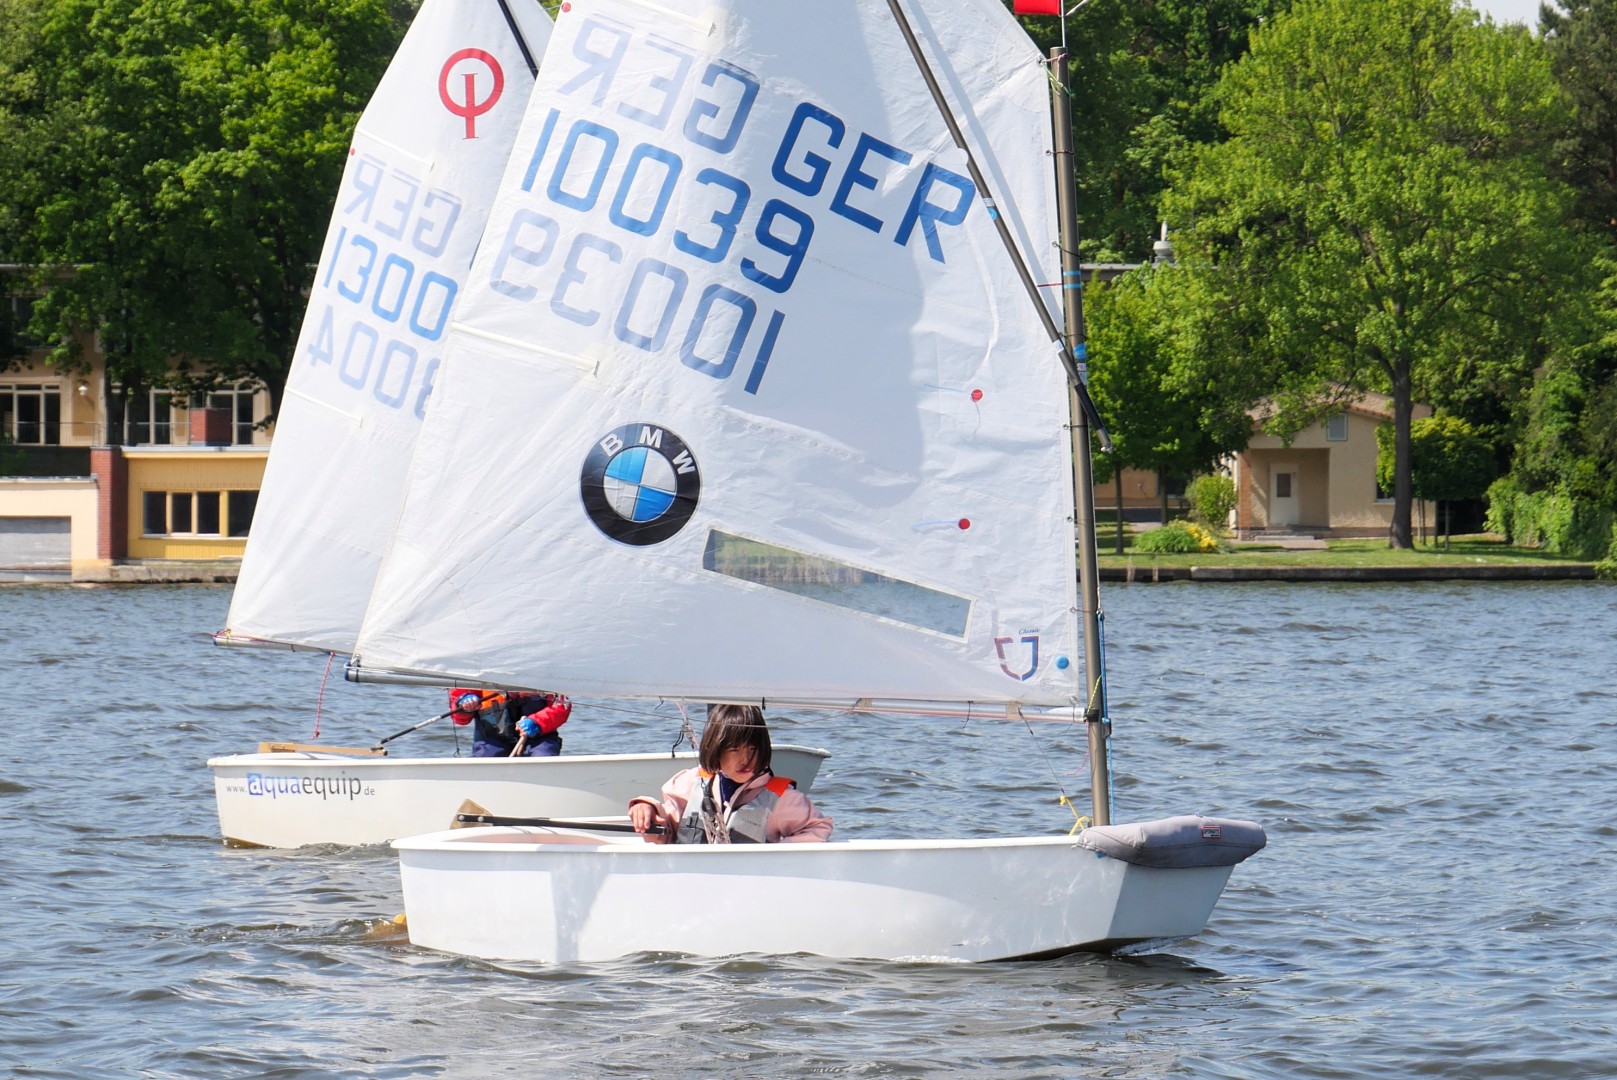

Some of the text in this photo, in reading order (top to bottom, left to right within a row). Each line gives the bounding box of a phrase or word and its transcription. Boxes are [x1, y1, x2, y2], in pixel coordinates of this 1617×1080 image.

[521, 108, 815, 293] 10039
[771, 102, 976, 264] GER
[600, 426, 696, 475] BMW
